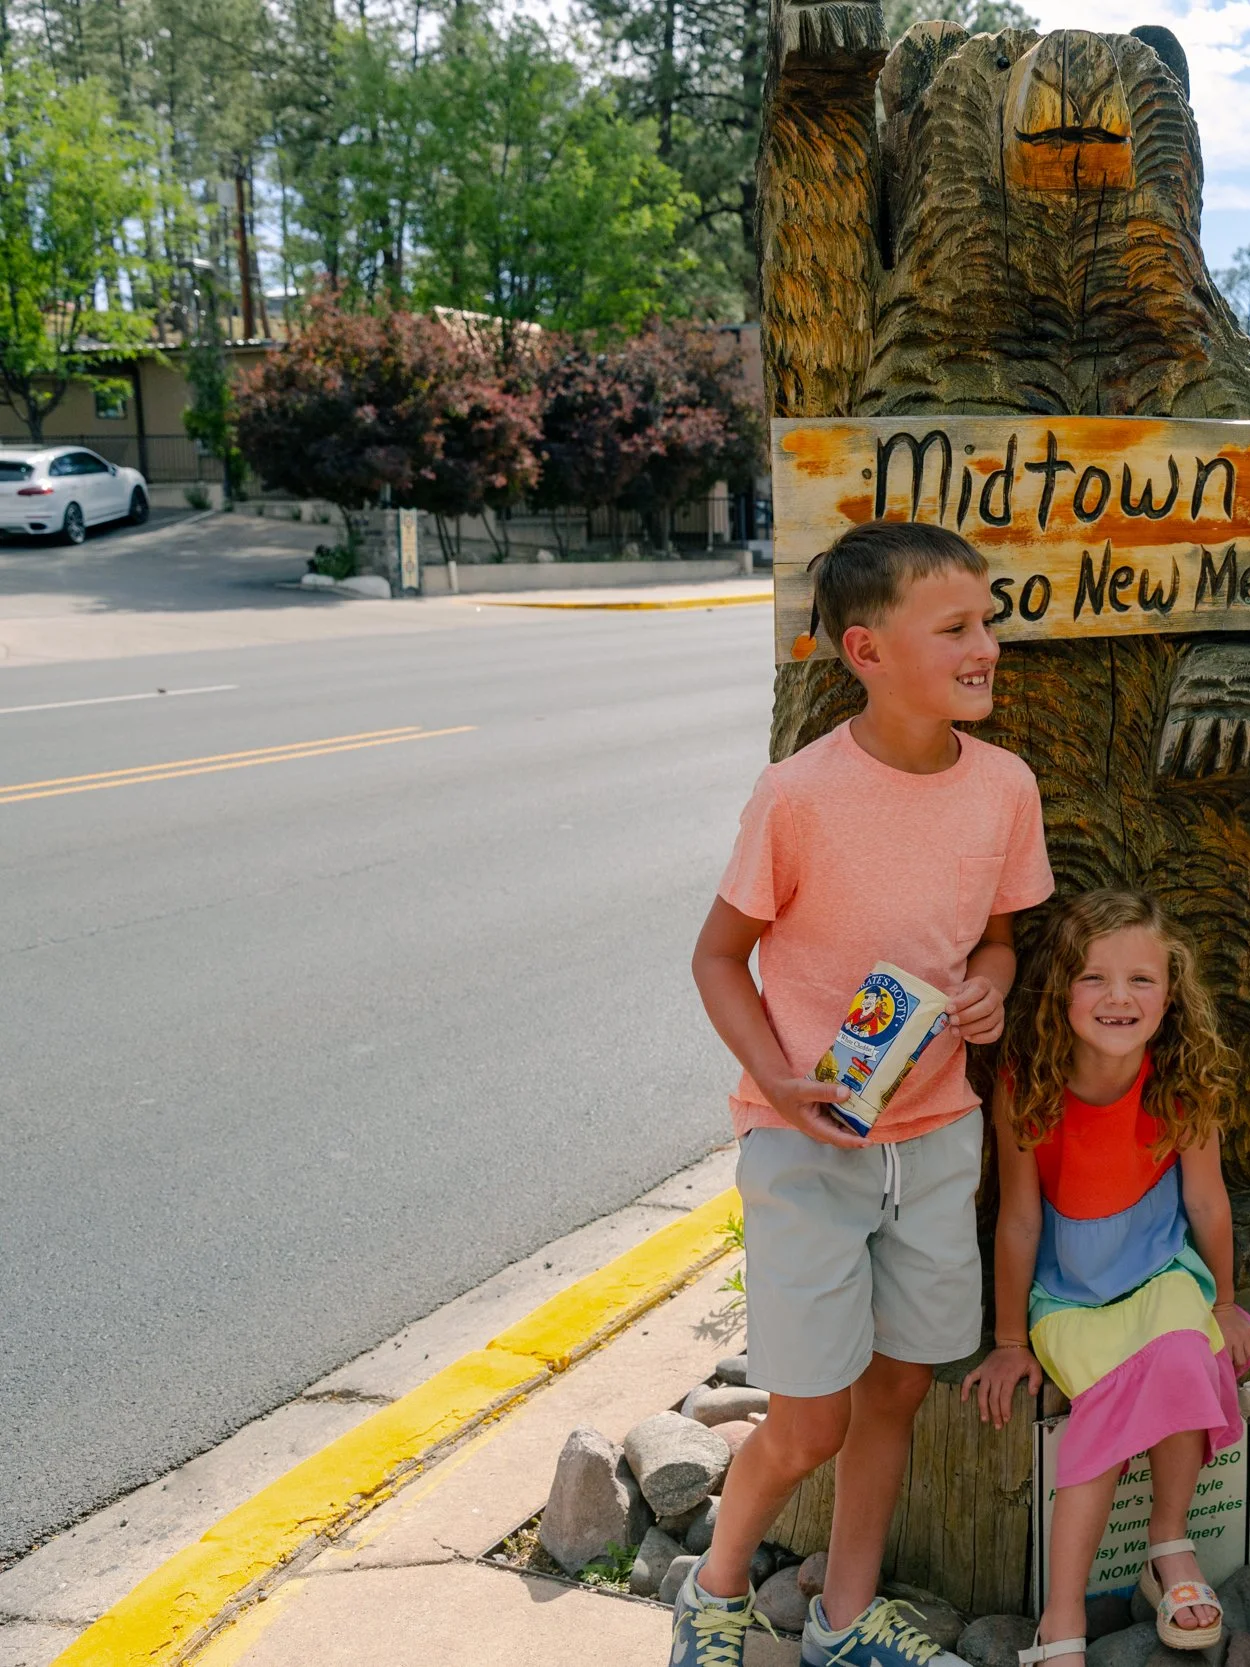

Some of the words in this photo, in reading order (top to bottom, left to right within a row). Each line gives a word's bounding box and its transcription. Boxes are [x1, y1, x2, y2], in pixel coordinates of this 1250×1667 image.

[874, 429, 1237, 532] Midtown
[1073, 538, 1180, 622] New
[889, 983, 907, 1022] BOOTY
[1187, 1499, 1243, 1520] pcakes
[1185, 1525, 1225, 1541] inery
